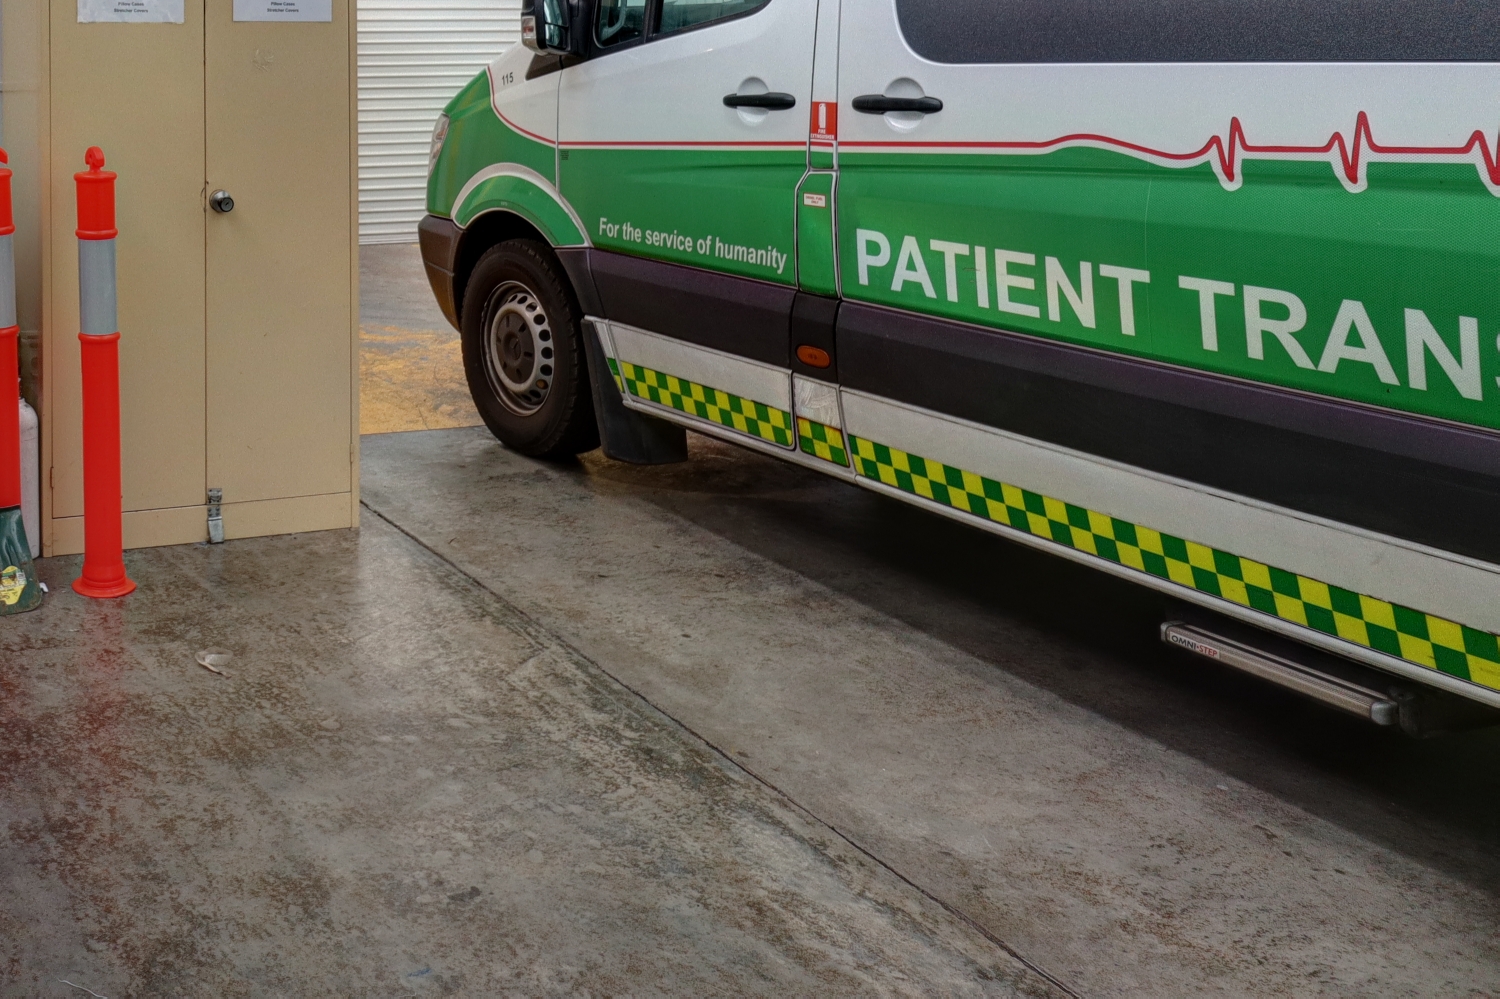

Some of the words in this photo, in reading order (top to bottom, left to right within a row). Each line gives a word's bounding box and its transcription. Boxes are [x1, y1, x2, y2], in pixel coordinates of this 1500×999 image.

[502, 72, 513, 85] 115
[599, 217, 620, 238] For
[622, 222, 641, 242] the
[645, 230, 692, 252] service
[697, 236, 712, 255] of
[715, 237, 786, 274] humanity
[855, 228, 1150, 337] PATIENT
[1178, 275, 1500, 402] TRAN
